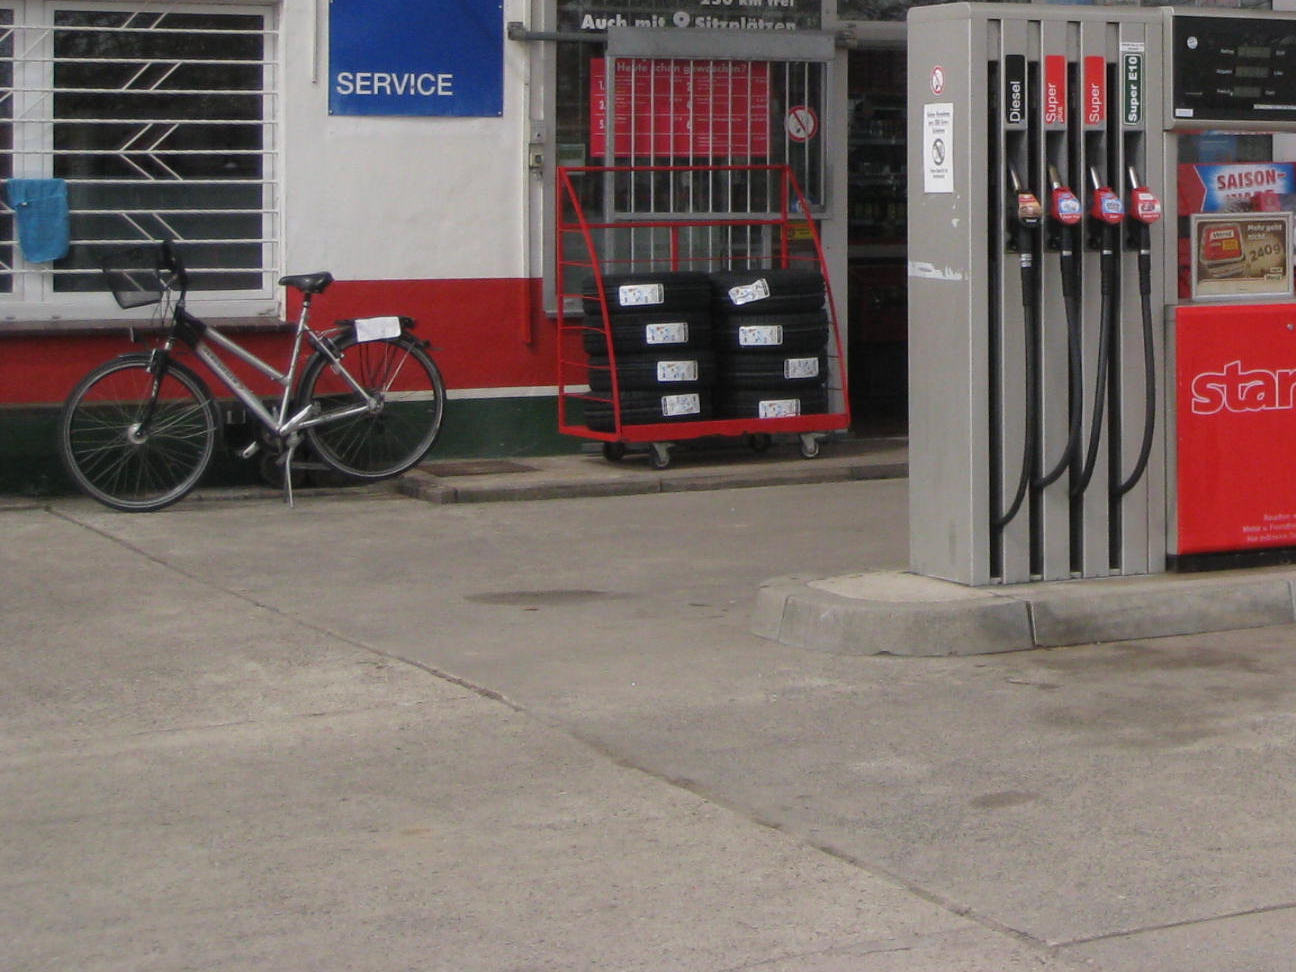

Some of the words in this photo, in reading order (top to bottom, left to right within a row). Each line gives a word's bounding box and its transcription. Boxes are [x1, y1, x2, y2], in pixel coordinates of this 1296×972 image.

[581, 14, 627, 30] Auch
[635, 15, 666, 28] mit
[336, 72, 453, 96] SERVICE
[1128, 56, 1138, 81] E10
[1009, 81, 1021, 123] Diesel
[1046, 83, 1060, 123] Super
[1089, 84, 1103, 123] Super
[1128, 85, 1140, 122] Super
[1217, 169, 1287, 191] SAISON-
